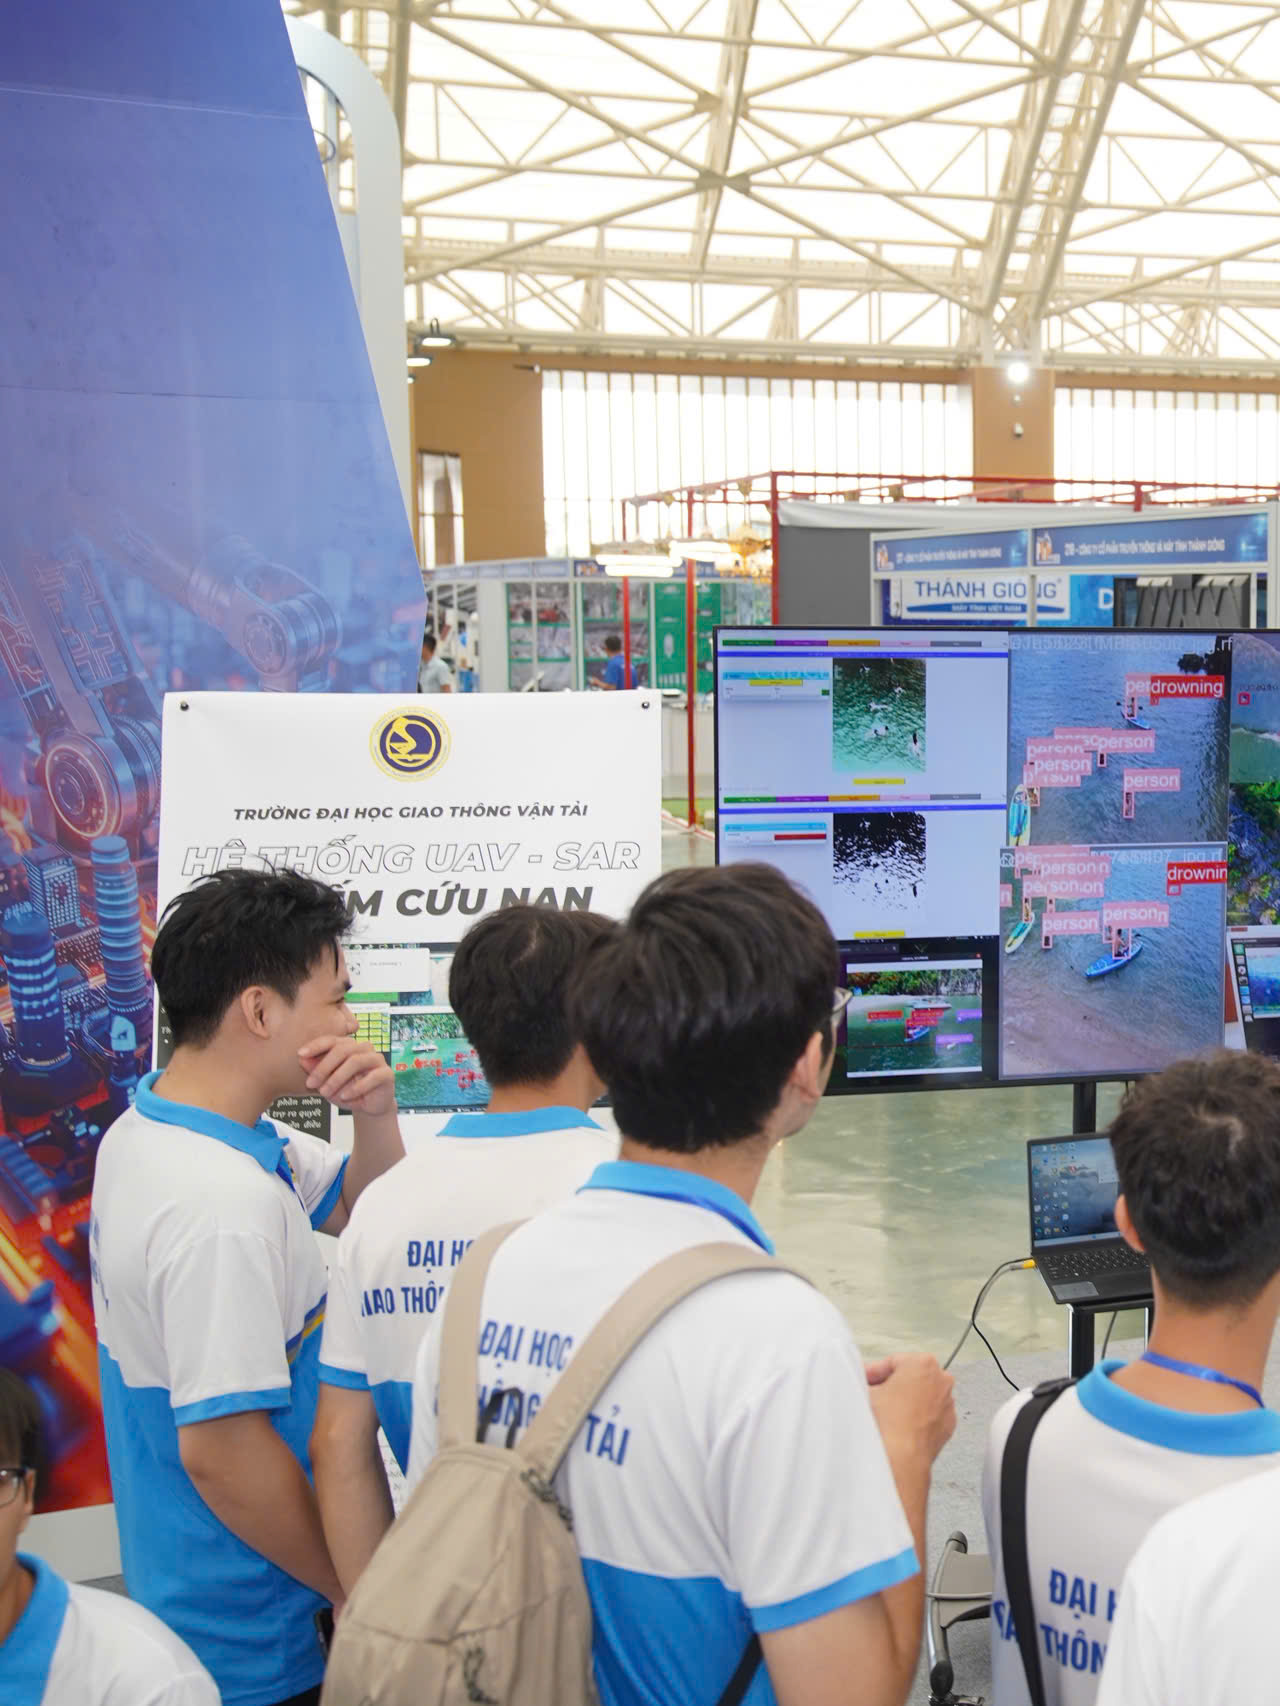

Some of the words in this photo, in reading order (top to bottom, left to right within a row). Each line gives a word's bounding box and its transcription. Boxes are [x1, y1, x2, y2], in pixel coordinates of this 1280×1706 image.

[914, 578, 985, 598] THÁNH
[1151, 678, 1224, 697] drowning
[1099, 735, 1154, 750] person
[1034, 758, 1091, 774] person
[1125, 773, 1180, 788] person
[234, 804, 312, 821] TRƯỜNG
[316, 805, 350, 823] ĐẠI
[354, 805, 395, 823] HỌC
[398, 805, 446, 819] GIAO
[449, 801, 514, 819] THÔNG
[517, 801, 557, 821] VẬN
[560, 800, 589, 818] TẢI
[425, 843, 520, 874] UAV
[552, 841, 641, 871] SAR
[1041, 862, 1097, 879] person
[1168, 866, 1227, 881] drownin
[396, 880, 488, 917] CỨU
[1043, 917, 1098, 933] person
[1104, 908, 1158, 923] person
[407, 1240, 444, 1273] ĐẠI
[361, 1287, 395, 1317] IAO
[401, 1280, 445, 1313] THÔ
[478, 1320, 525, 1369] ĐẠI
[528, 1330, 574, 1378] HỌC
[586, 1404, 631, 1466] TẢI
[1049, 1568, 1098, 1620] ĐẠI
[1039, 1622, 1108, 1675] THÔN
